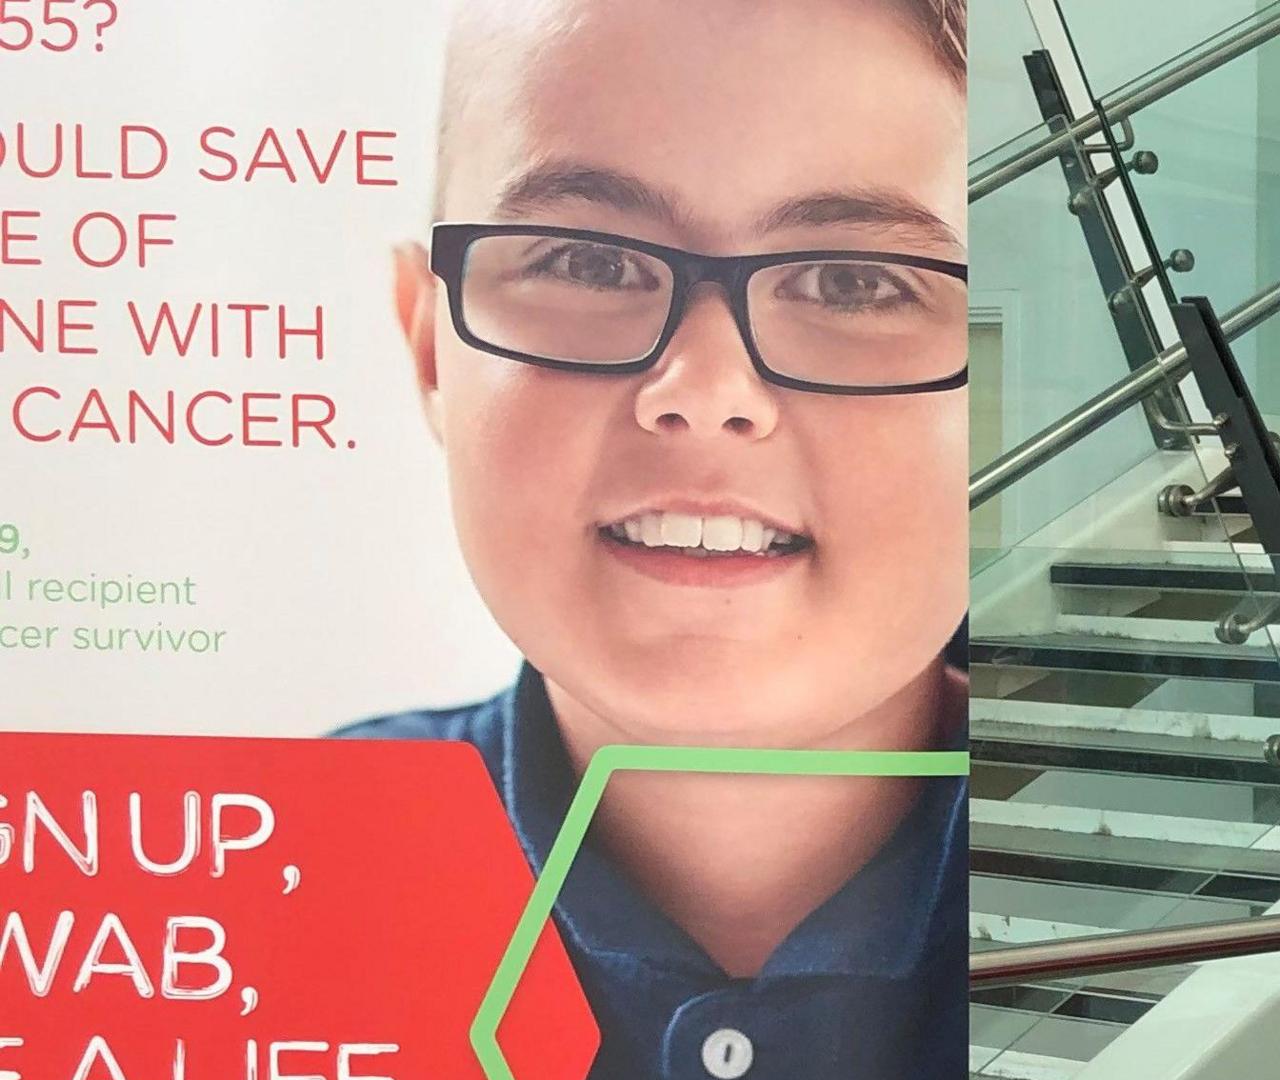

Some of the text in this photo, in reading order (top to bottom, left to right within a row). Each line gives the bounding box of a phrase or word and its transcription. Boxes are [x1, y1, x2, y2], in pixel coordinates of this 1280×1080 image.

[0, 121, 397, 187] ULD SAVE
[71, 211, 177, 268] OF
[0, 298, 325, 361] NE WITH
[12, 386, 357, 449] CANCER.
[0, 523, 31, 561] 9,
[28, 571, 198, 611] recipient
[0, 621, 228, 653] cer survivor
[130, 790, 302, 894] UP,
